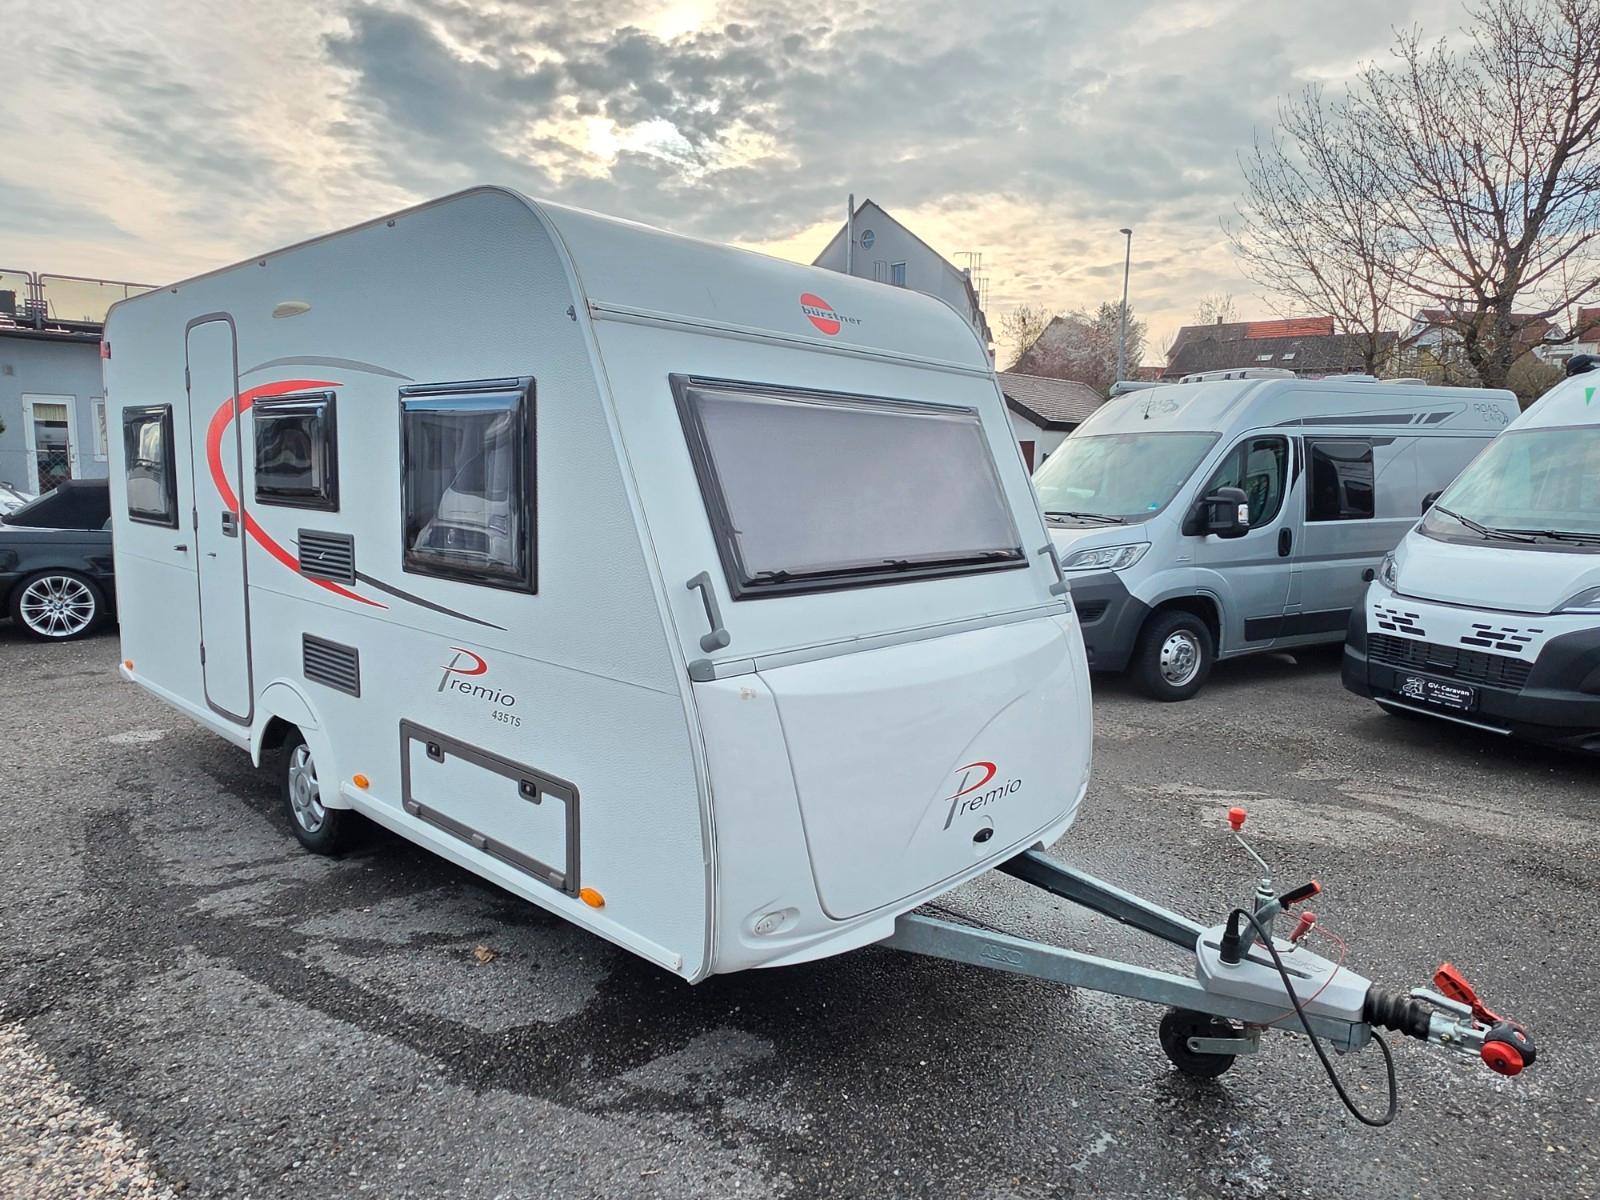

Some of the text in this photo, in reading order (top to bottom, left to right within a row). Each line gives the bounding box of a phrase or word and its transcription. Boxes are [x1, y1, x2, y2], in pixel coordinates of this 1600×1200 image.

[801, 305, 862, 325] bürstner
[438, 646, 515, 707] Premio
[1441, 685, 1470, 697] Caravan
[491, 710, 521, 727] 435TS
[943, 761, 1022, 831] Premio
